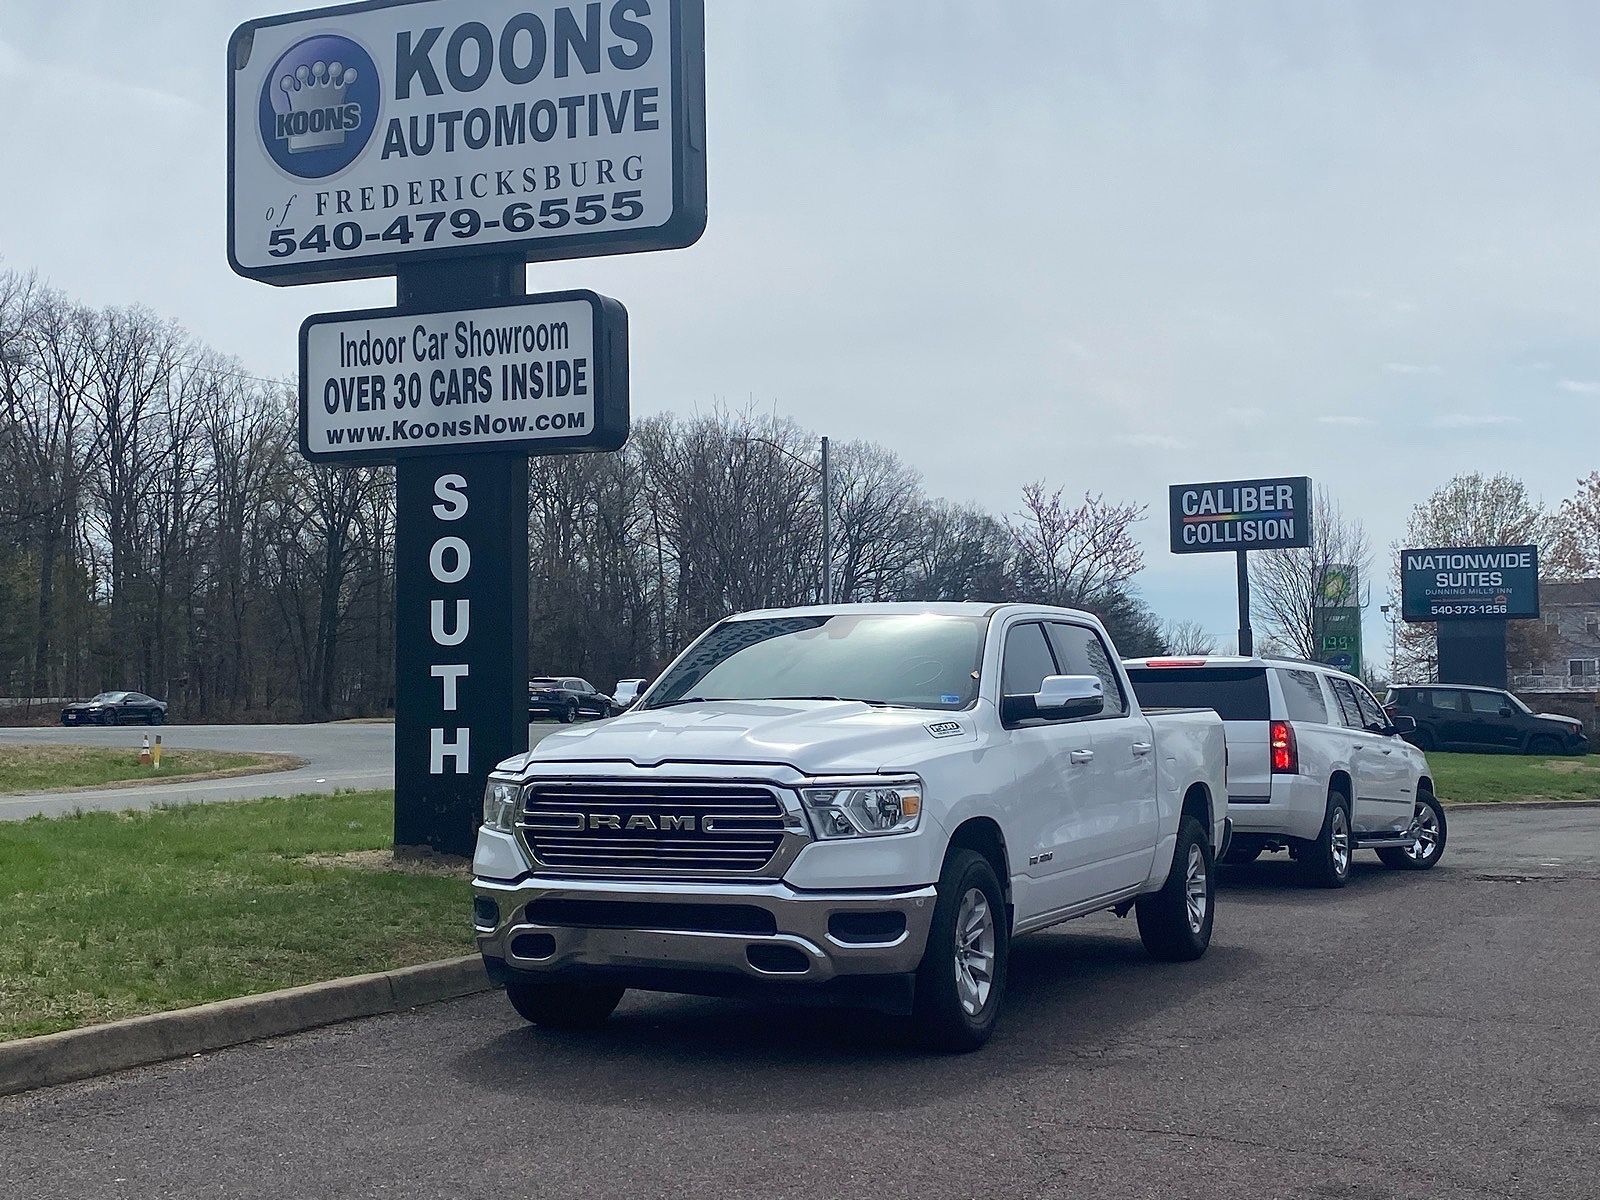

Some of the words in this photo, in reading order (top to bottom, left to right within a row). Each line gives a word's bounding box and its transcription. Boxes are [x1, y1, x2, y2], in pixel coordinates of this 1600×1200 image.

[395, 0, 653, 100] KOONS
[276, 103, 361, 138] KOONS
[381, 87, 659, 160] AUTOMOTIVE
[265, 194, 297, 227] of
[315, 155, 644, 217] FREDERICKSBURG
[268, 190, 644, 258] 540-479-6555
[340, 330, 406, 368] Indoor
[412, 325, 449, 362] Car
[455, 320, 569, 359] Showroom
[324, 374, 386, 415] OVER
[393, 372, 420, 409] 30
[430, 365, 492, 407] CARS
[502, 358, 587, 401] INSIDE
[1181, 485, 1294, 516] CALIBER
[1183, 518, 1294, 545] COLLISION
[1407, 553, 1531, 570] NATIONWIDE
[1425, 588, 1466, 596] DUNNING
[1436, 572, 1502, 588] SUITES
[429, 473, 471, 774] SOUTH
[1430, 604, 1507, 615] 540-373-1256
[930, 722, 958, 733] 1500
[589, 813, 695, 831] RAM
